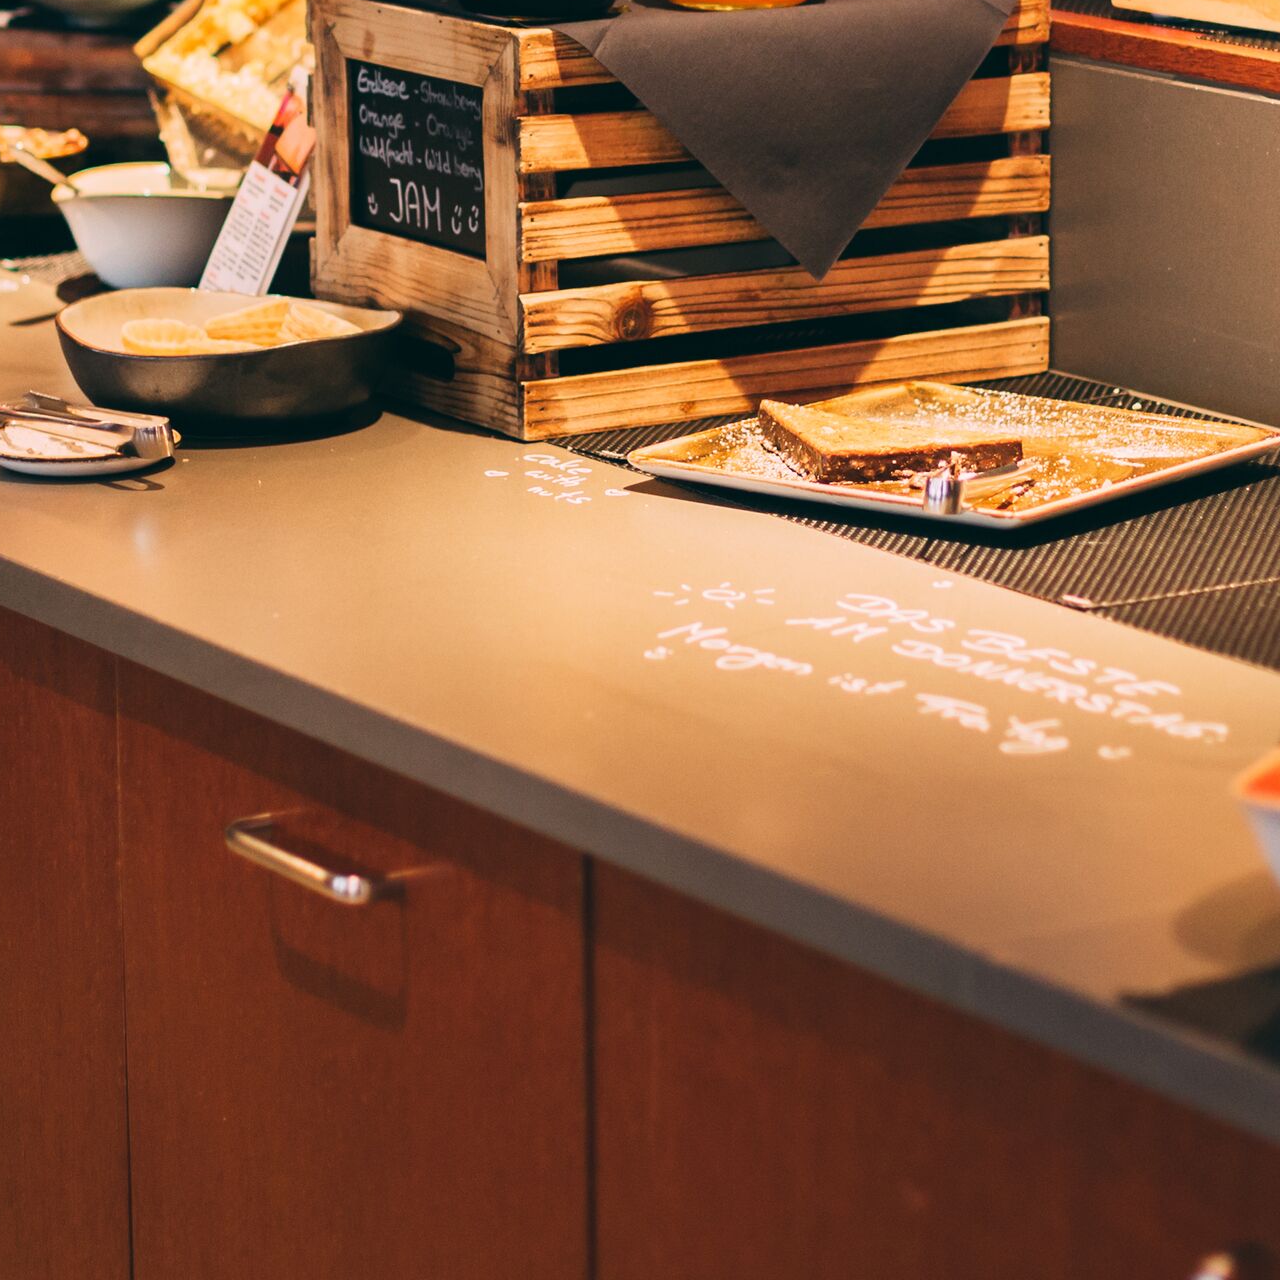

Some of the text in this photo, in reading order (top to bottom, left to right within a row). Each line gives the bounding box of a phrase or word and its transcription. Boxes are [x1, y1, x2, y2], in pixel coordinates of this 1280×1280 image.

[359, 104, 406, 139] Orange
[426, 113, 474, 151] Orange
[388, 177, 442, 232] JAM
[524, 469, 587, 488] with
[784, 616, 890, 644] AM
[835, 592, 1183, 696] DAS BESTE
[656, 620, 814, 676] Morgen
[827, 671, 908, 695] ist
